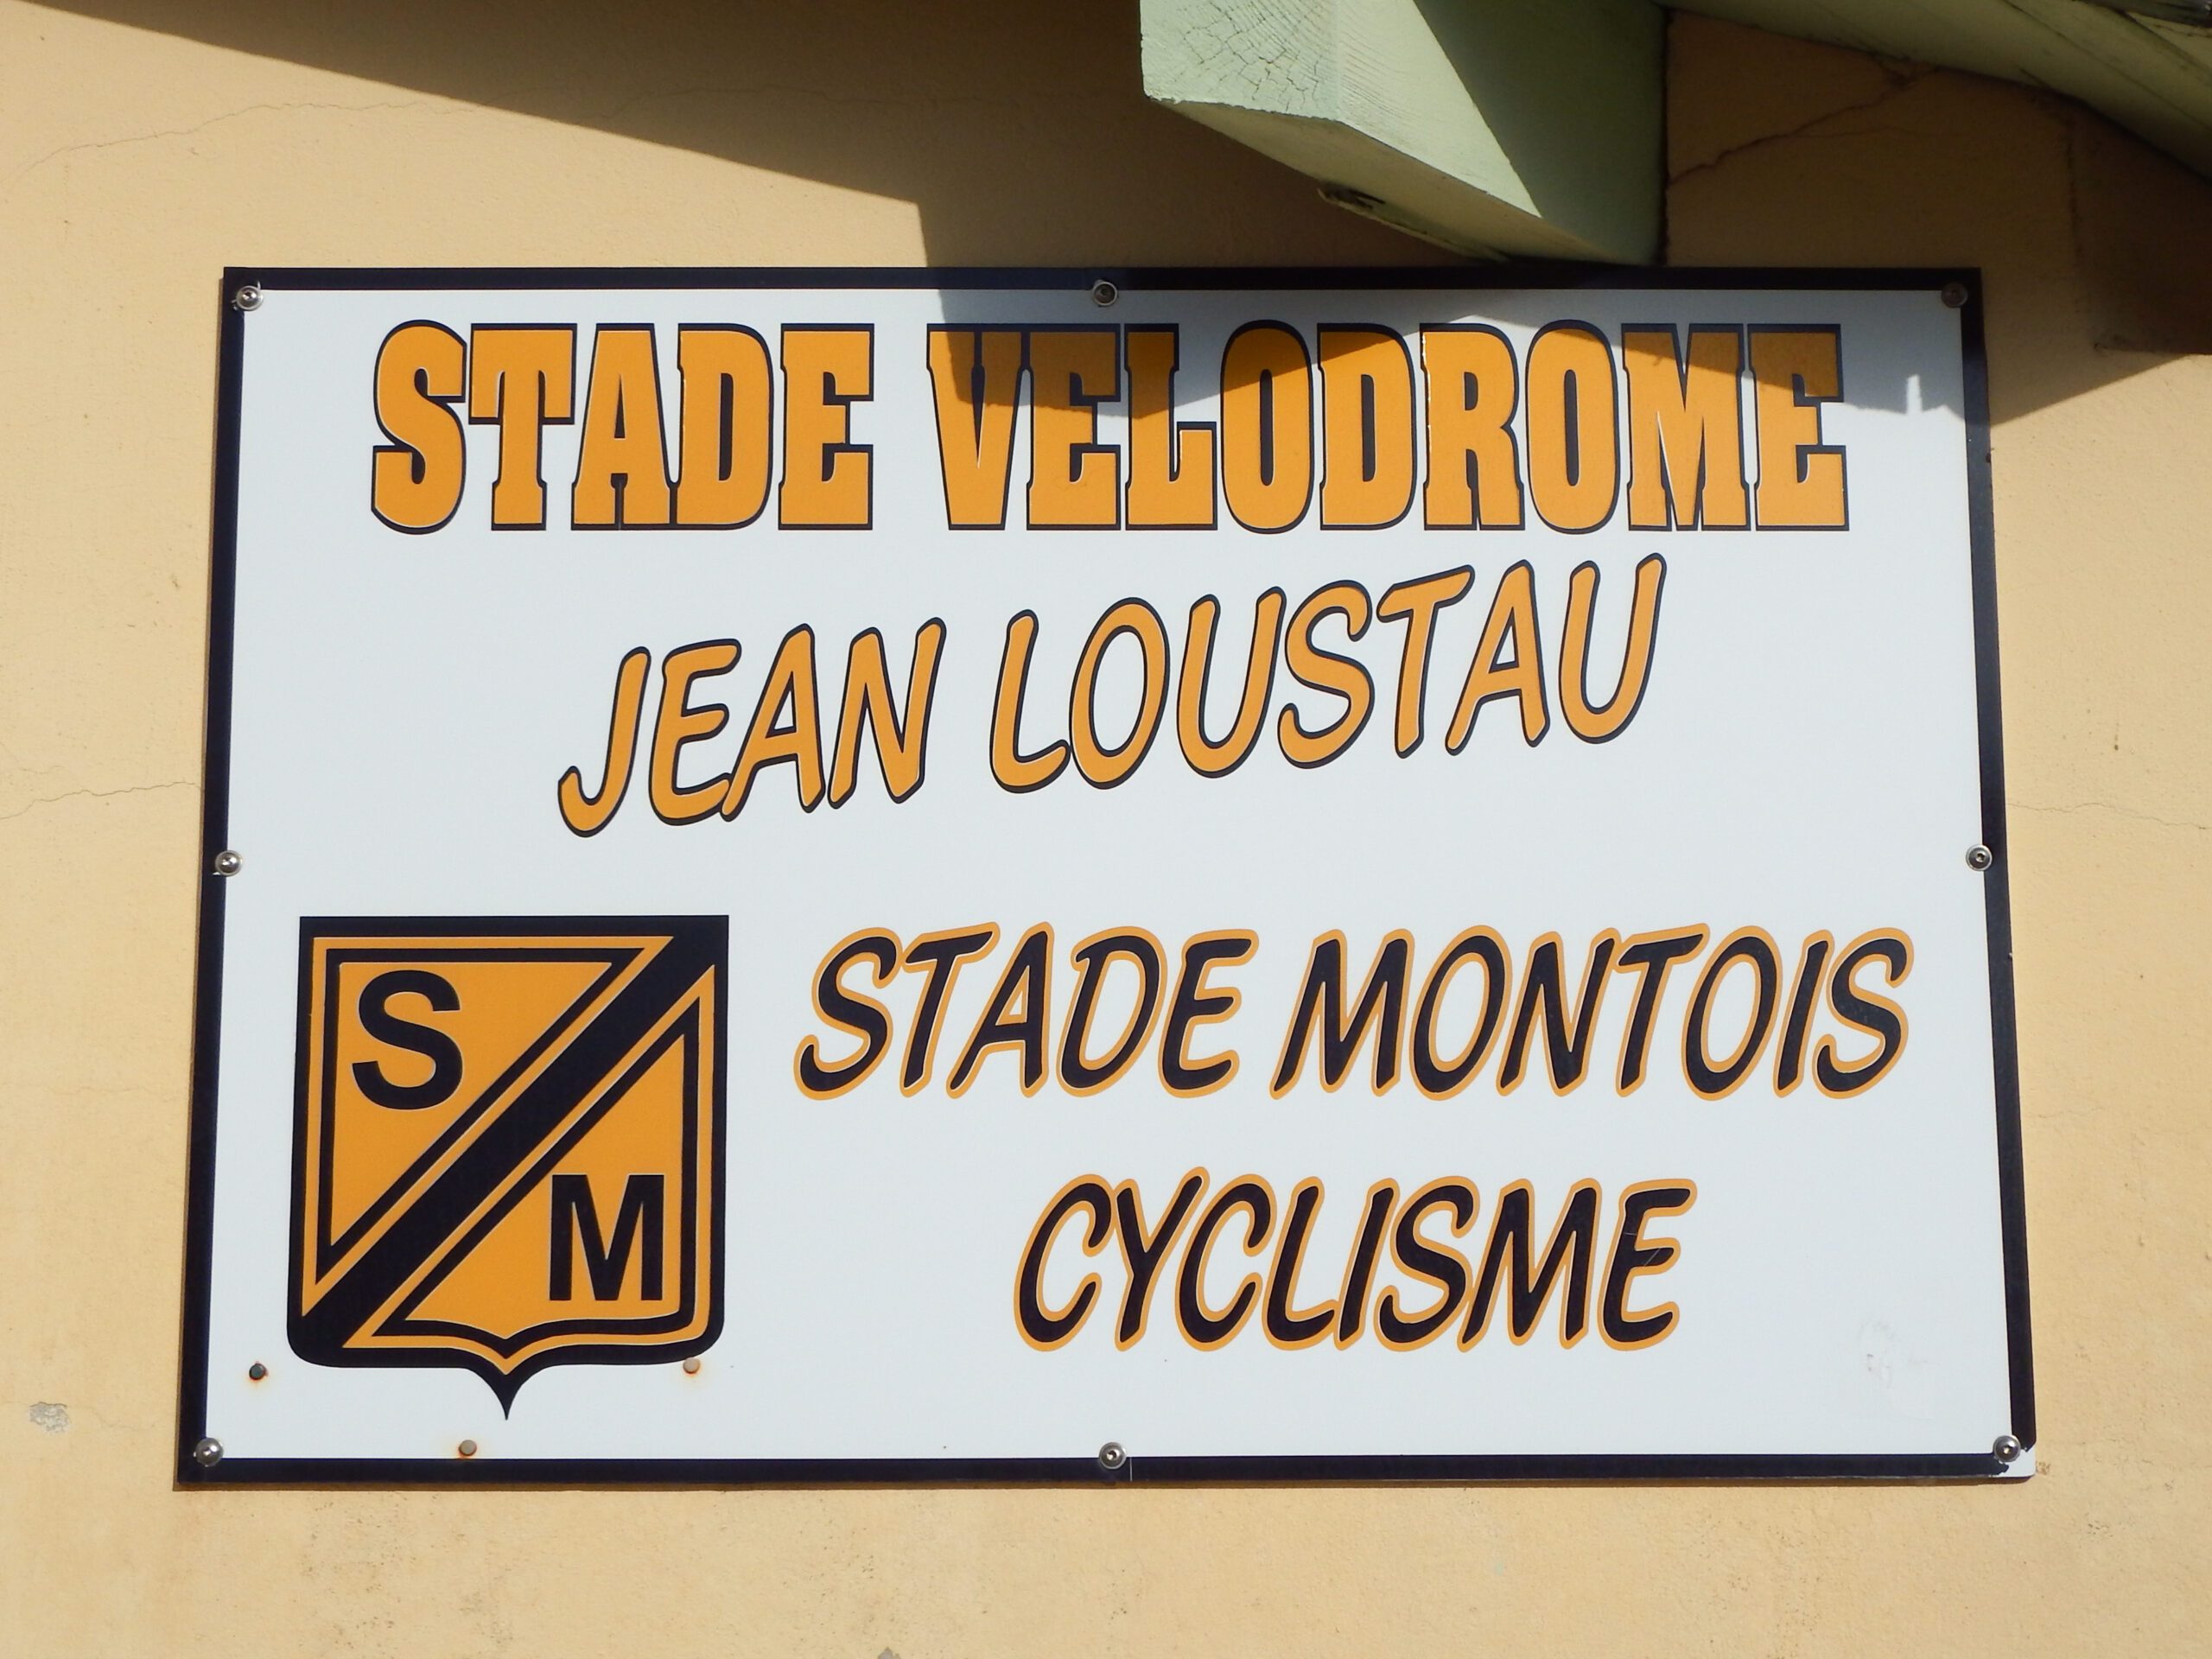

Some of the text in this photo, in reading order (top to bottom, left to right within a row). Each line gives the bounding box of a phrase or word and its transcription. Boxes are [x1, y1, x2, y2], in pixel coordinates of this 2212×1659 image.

[371, 319, 1849, 535] STADE VELODROME
[557, 552, 1667, 837] JEAN LOUSTAU
[793, 921, 1915, 1102] STADE MONTOIS
[1013, 1166, 1699, 1353] CYCLISME
